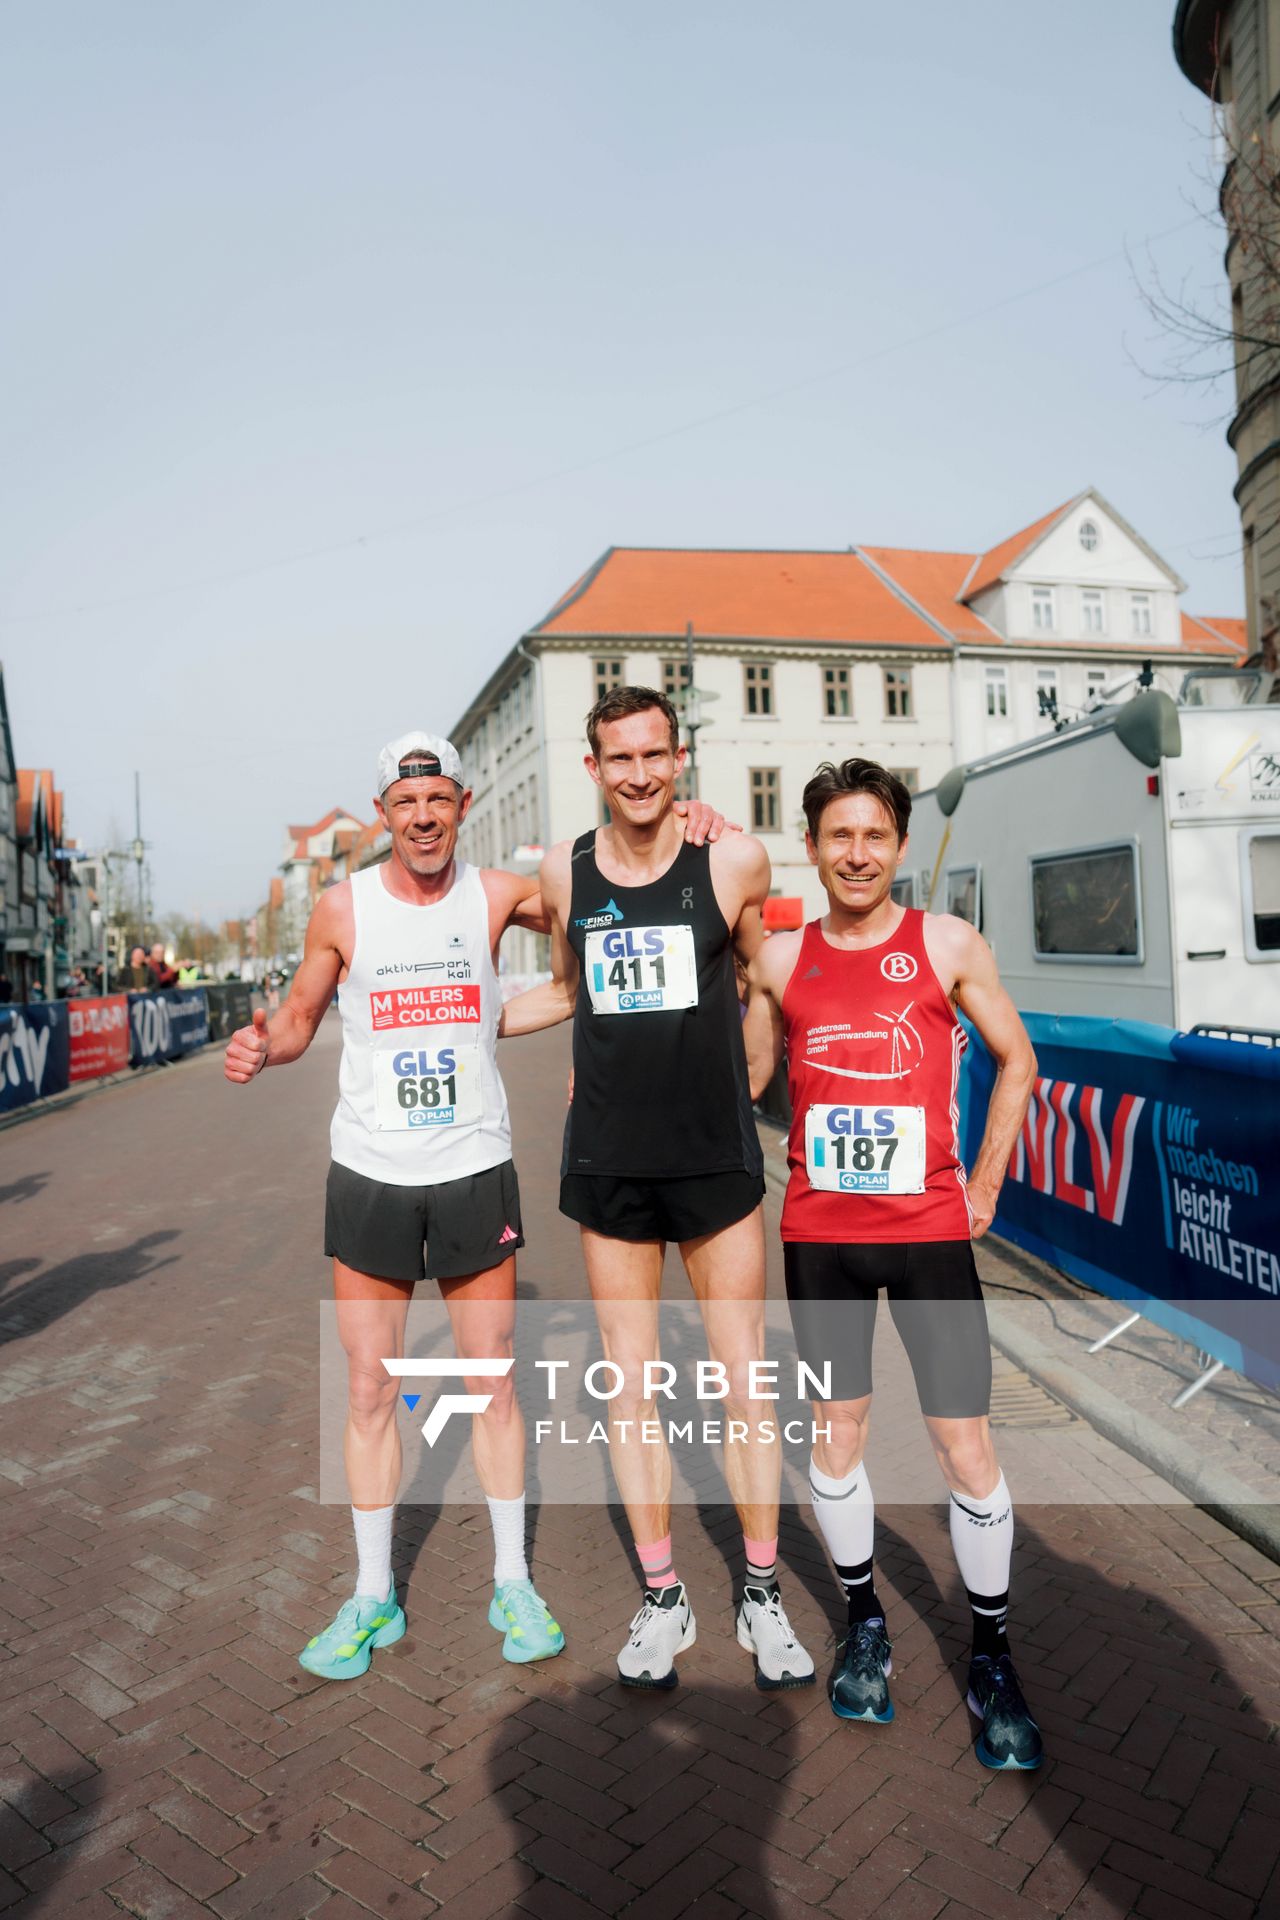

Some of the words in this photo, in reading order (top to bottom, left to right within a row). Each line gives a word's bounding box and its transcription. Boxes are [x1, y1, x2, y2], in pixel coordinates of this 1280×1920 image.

[602, 928, 665, 959] GLS
[447, 969, 471, 979] kall
[608, 956, 666, 991] 411
[397, 988, 464, 1007] MILERS
[635, 993, 661, 1003] PLAN
[398, 1006, 479, 1024] COLONIA
[806, 1023, 851, 1037] windstream
[392, 1049, 456, 1077] GLS
[397, 1075, 457, 1109] 681
[427, 1110, 452, 1120] PLAN
[826, 1107, 895, 1137] GLS
[1166, 1103, 1200, 1147] Wir
[831, 1136, 899, 1172] 187
[1009, 1076, 1146, 1226] NLV
[859, 1175, 887, 1185] PLAN
[1166, 1144, 1259, 1197] machen
[1173, 1177, 1232, 1234] leicht
